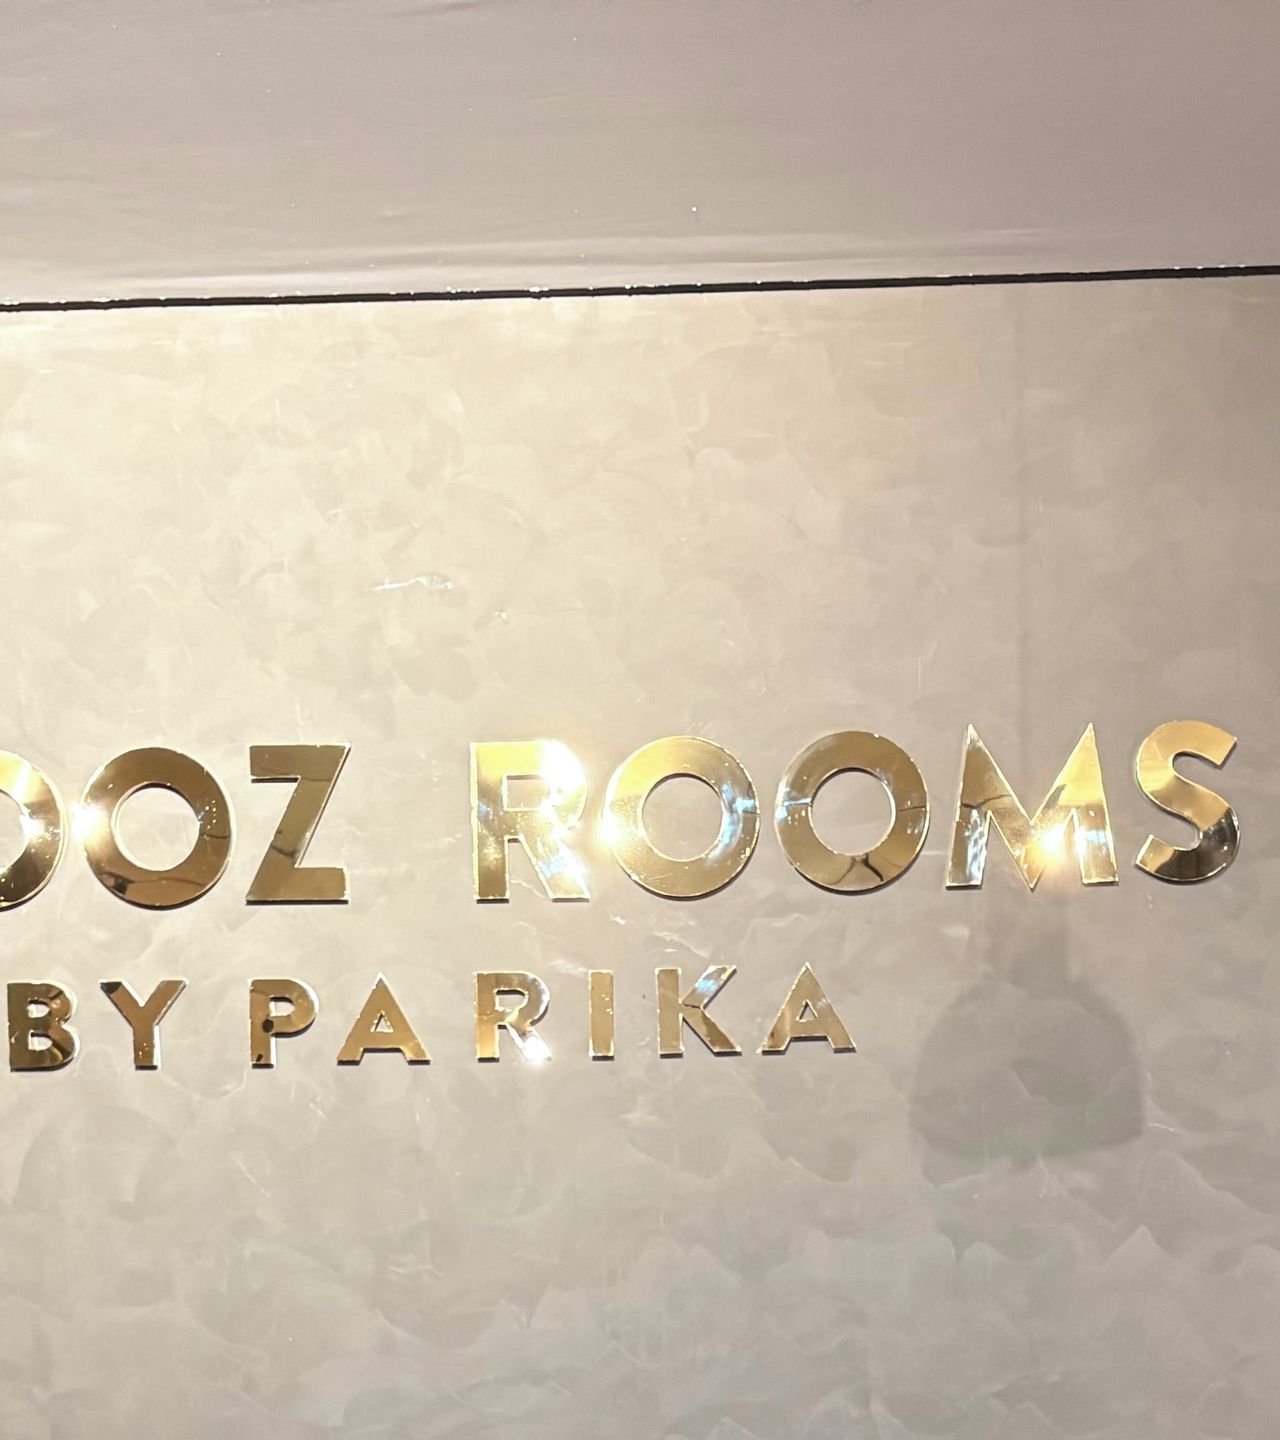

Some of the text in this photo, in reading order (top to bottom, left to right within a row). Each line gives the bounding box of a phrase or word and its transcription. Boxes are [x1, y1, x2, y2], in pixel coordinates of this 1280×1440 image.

[469, 719, 1241, 904] ROOMS
[7, 962, 857, 1072] BY PARIKA
